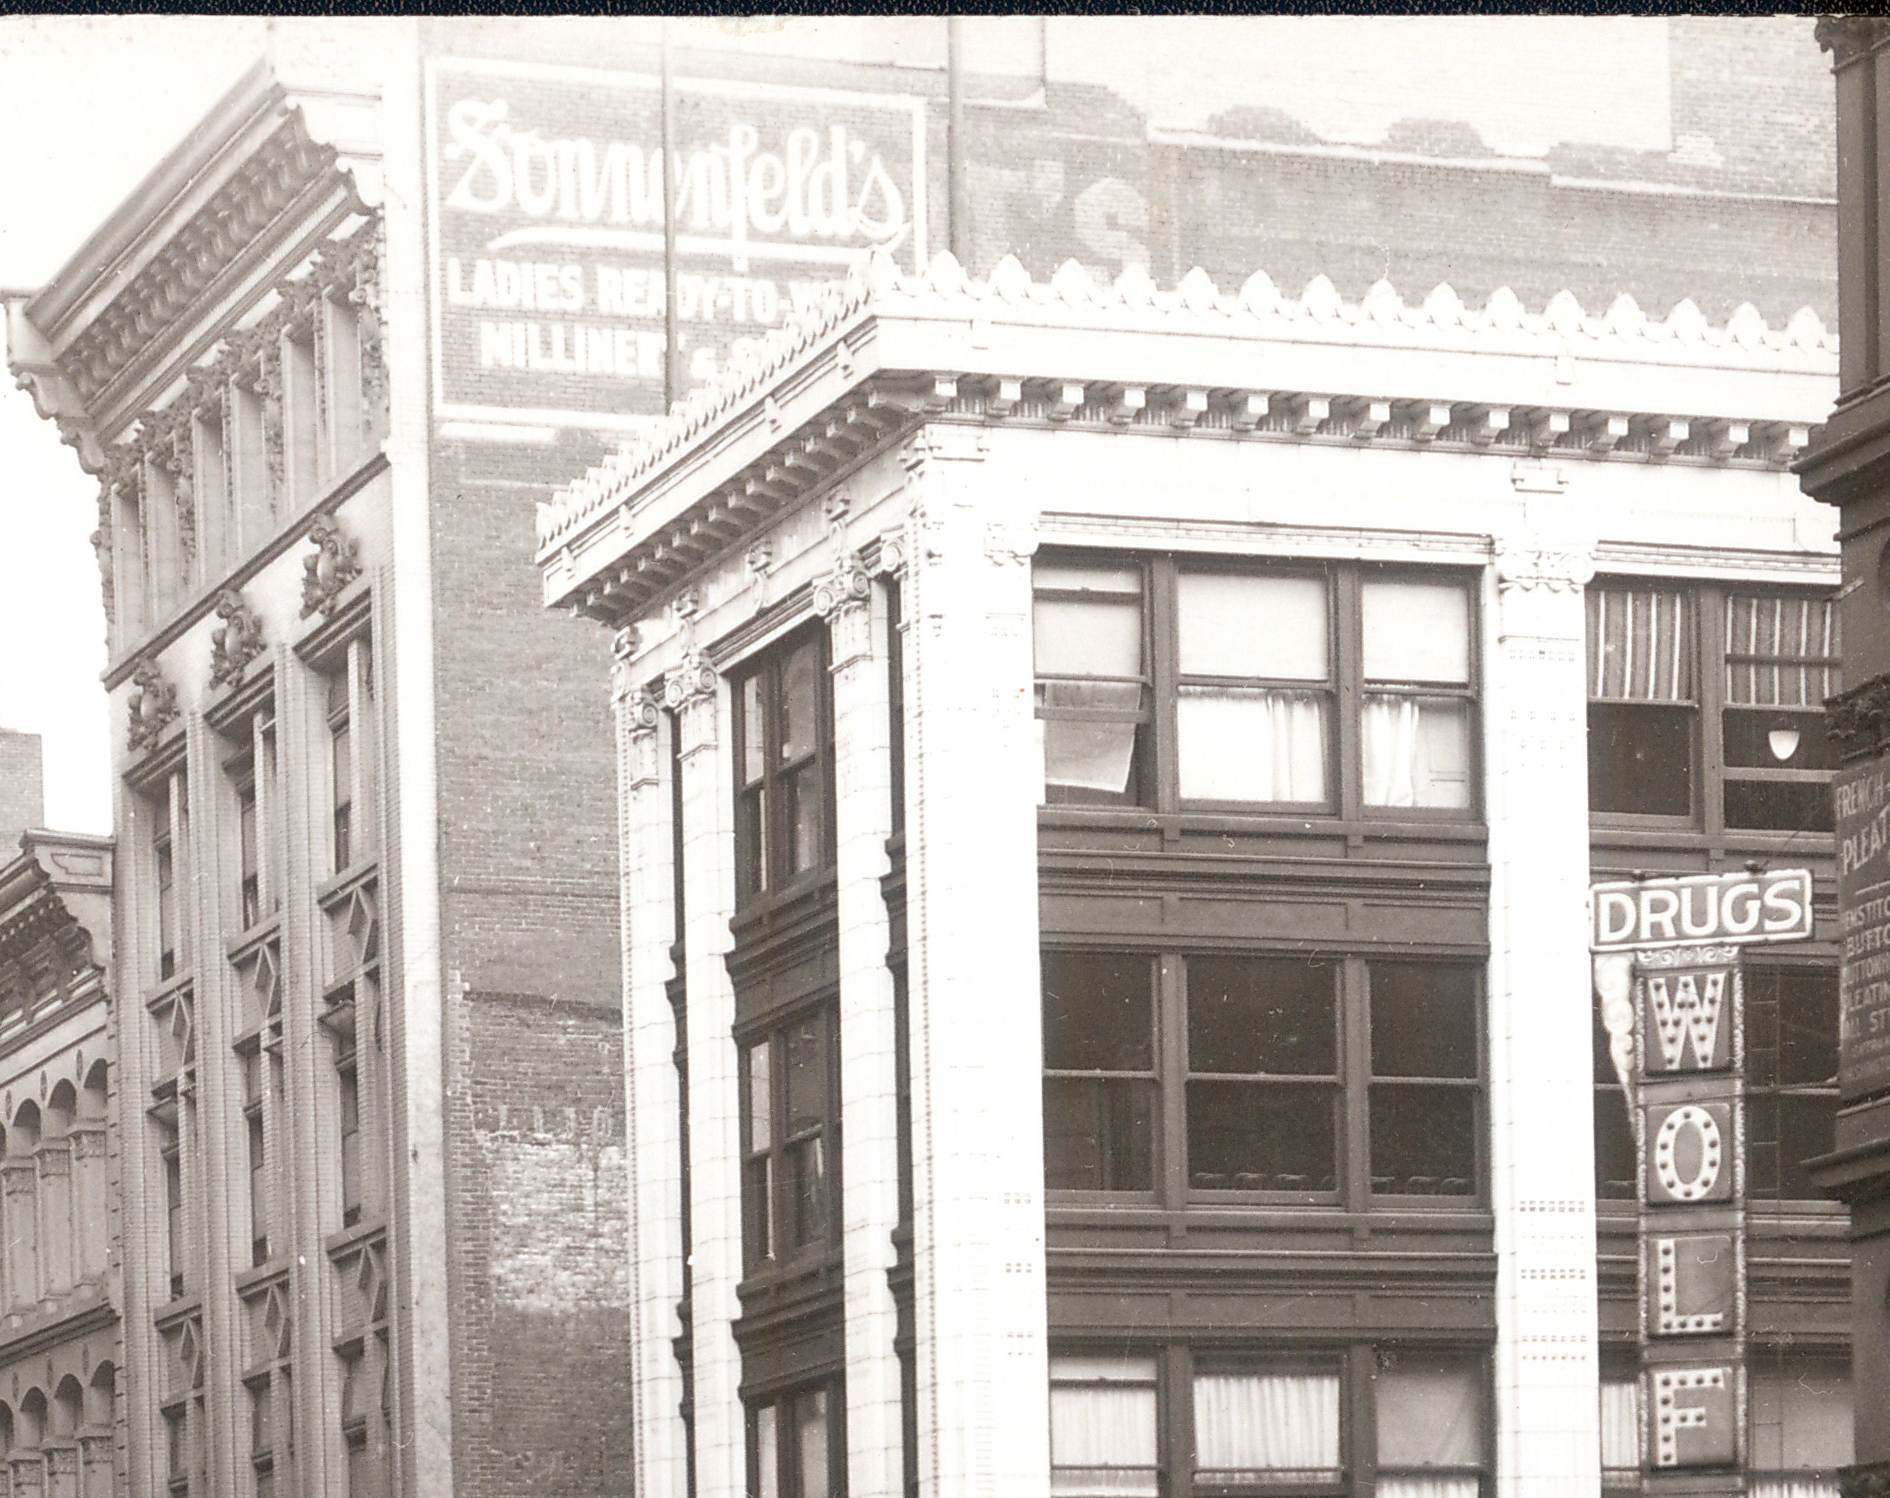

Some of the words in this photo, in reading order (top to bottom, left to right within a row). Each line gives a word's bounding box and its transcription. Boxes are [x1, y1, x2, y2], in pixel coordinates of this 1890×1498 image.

[446, 98, 910, 250] Sonnenfeld's
[448, 257, 584, 311] LADIES
[1598, 878, 1806, 944] DRUGS
